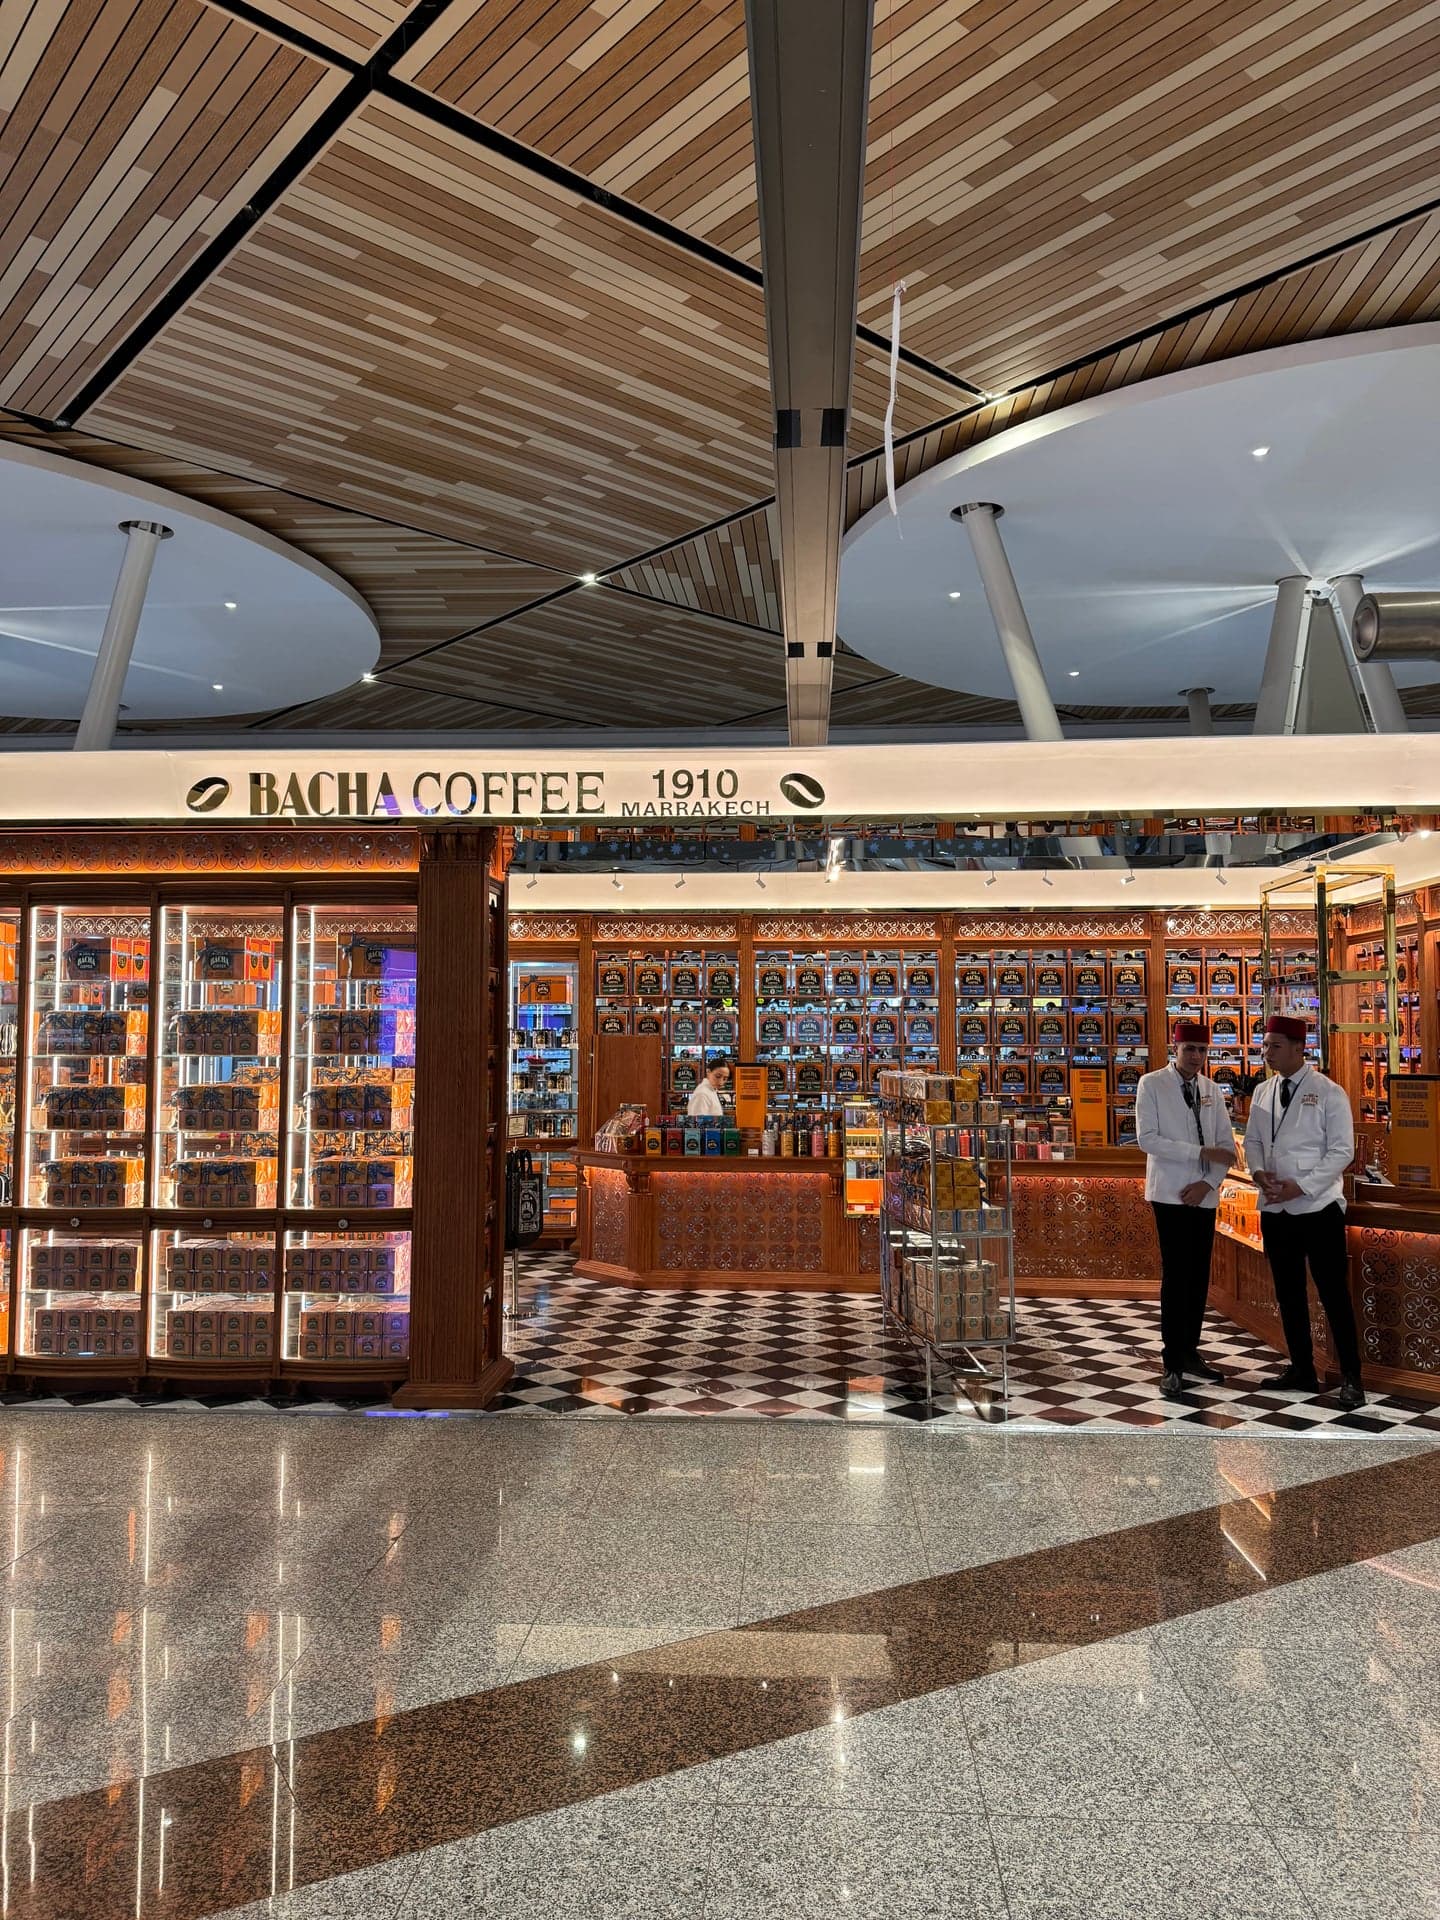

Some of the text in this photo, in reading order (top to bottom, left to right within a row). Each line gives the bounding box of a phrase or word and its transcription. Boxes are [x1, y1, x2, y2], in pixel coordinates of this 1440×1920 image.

[249, 771, 605, 815] BACHA COFFEE
[652, 769, 738, 798] 1910
[621, 801, 769, 816] MARRAKECH
